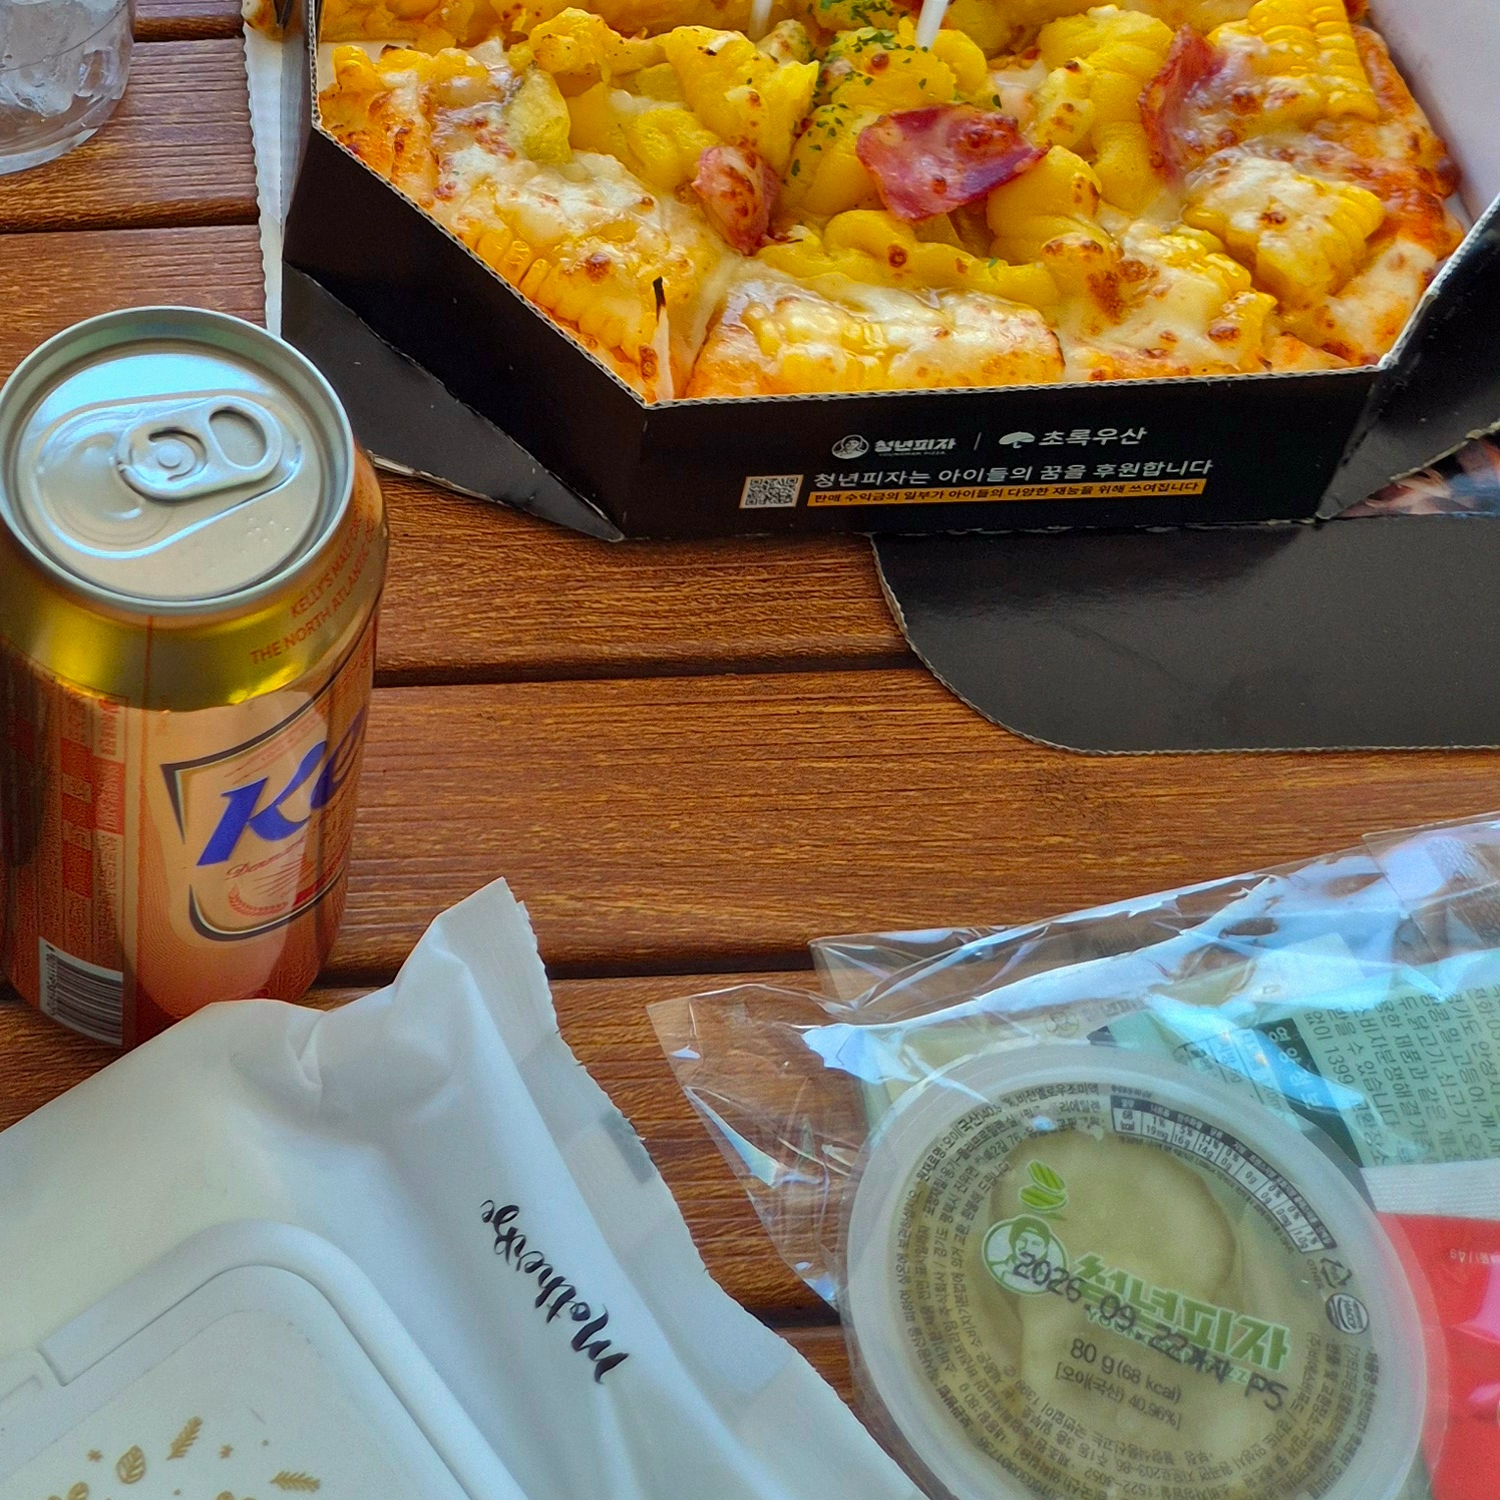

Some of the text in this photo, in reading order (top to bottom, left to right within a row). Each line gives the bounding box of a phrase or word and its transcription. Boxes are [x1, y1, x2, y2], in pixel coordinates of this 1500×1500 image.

[873, 427, 1148, 453] 청년피자 초록우산
[813, 458, 1214, 489] 청년피자는 아이들의 꿈을 후원합니다
[815, 480, 1200, 505] 판매 수익금의 일부가 아이들의 다양한 재능을 위해 쓰여집니다
[248, 640, 284, 665] THE
[281, 605, 333, 651] NORTH
[1304, 1009, 1356, 1086] 없이 1399
[1392, 1031, 1428, 1080] 제품과
[1069, 1338, 1098, 1364] 80
[1145, 1372, 1183, 1405] kcal)
